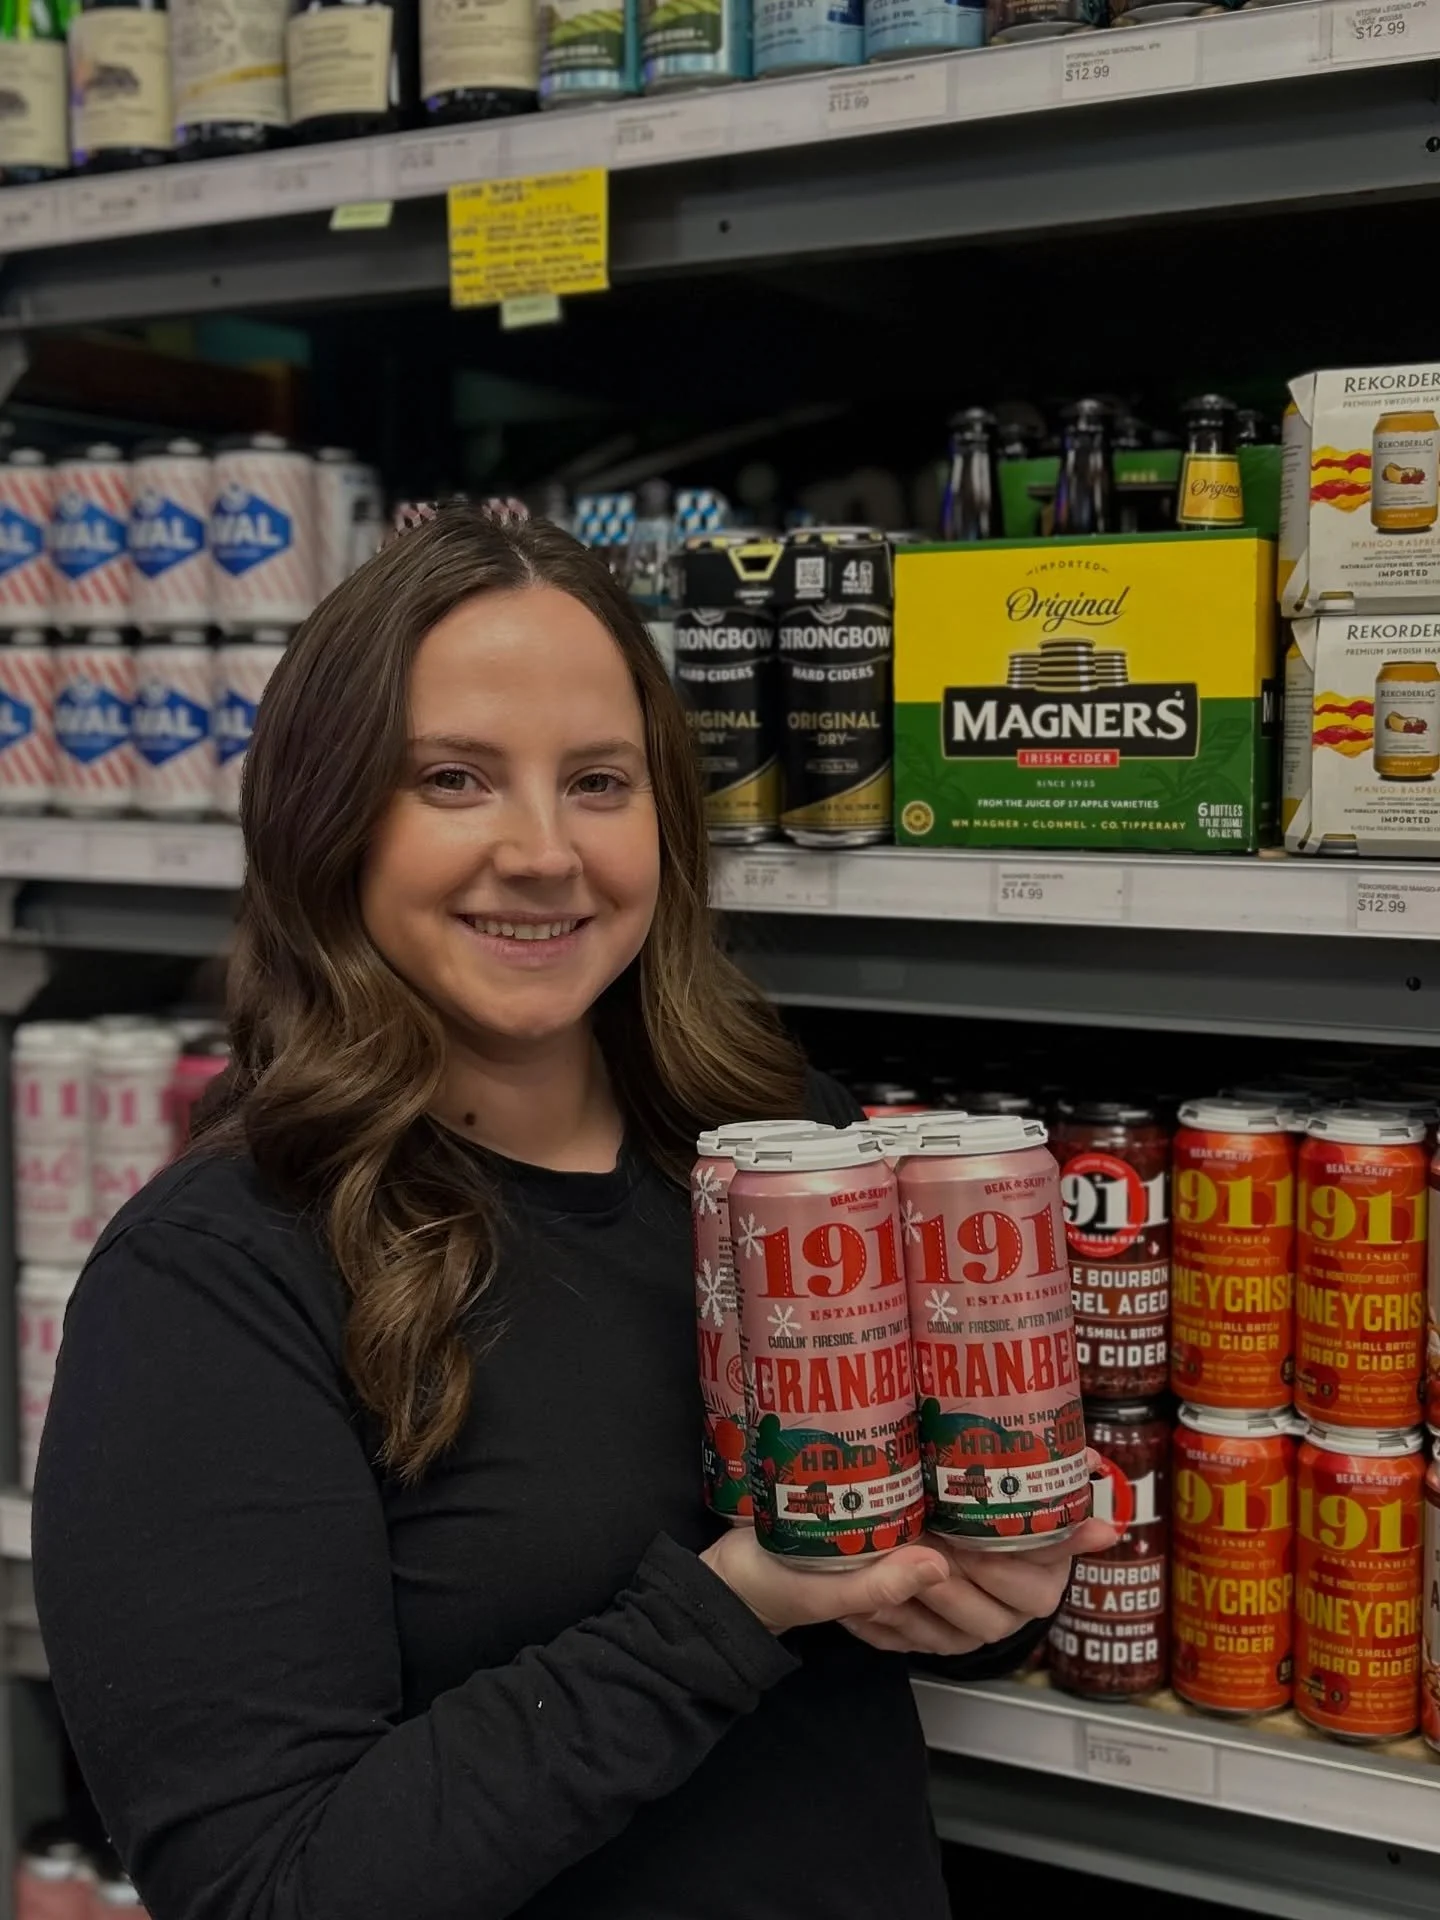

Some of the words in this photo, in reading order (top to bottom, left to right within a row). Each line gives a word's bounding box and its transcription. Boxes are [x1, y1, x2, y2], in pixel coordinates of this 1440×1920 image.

[1356, 21, 1405, 40] $12.99
[1065, 65, 1110, 82] $12.99
[1033, 560, 1102, 574] IMPORTED
[1378, 569, 1428, 578] IMPORTED
[1006, 586, 1131, 633] Original
[674, 626, 775, 651] RONGBOW
[779, 626, 892, 650] STRONGBOW
[1347, 624, 1440, 641] REKORDER
[1346, 647, 1383, 655] PREMIUM
[1386, 647, 1422, 655] SWEDISH
[707, 666, 754, 683] CIDERS
[792, 666, 825, 682] HARD
[827, 666, 875, 683] CIDERS
[1380, 689, 1436, 698] REKORDERLIG
[685, 709, 763, 729] RIGINAL
[787, 711, 881, 730] ORIGINAL
[952, 695, 1188, 742] MAGNERS
[817, 732, 848, 746] DRY
[1024, 753, 1063, 765] IRISH
[1067, 753, 1112, 765] CIDER
[1036, 780, 1066, 788] SINCE
[977, 799, 1003, 808] FROM
[1004, 799, 1024, 808] THE
[1025, 799, 1051, 808] JUICE
[1053, 799, 1066, 808] OF
[1067, 799, 1079, 808] 17
[1080, 799, 1109, 809] APPLE
[1111, 799, 1159, 809] VARIETIES
[1198, 802, 1208, 817] 6
[1210, 804, 1243, 817] BOTTLES
[951, 819, 969, 828] WM
[973, 819, 1020, 829] MAGNER
[1032, 820, 1087, 830] CLONMEL
[1381, 816, 1431, 825] IMPORTED
[1001, 888, 1043, 900] $14.99
[1357, 898, 1406, 913] $12.99
[1326, 1164, 1350, 1175] BEAK
[1363, 1166, 1394, 1178] SKIFF
[985, 1181, 1013, 1195] BEAK
[1014, 1179, 1022, 1188] &
[1023, 1178, 1046, 1190] SKIFF
[830, 1192, 858, 1207] BEAK
[859, 1190, 866, 1199] &
[867, 1188, 889, 1200] SKIFF
[1314, 1246, 1410, 1262] ESTABLISHED
[1087, 1267, 1169, 1288] BOURBON
[1118, 1289, 1169, 1316] AGED
[1018, 1314, 1045, 1329] AFTER
[1047, 1309, 1064, 1325] THAT
[1207, 1318, 1243, 1332] SMALL
[1246, 1320, 1279, 1333] BATCH
[860, 1326, 887, 1343] AFTER
[1087, 1326, 1128, 1340] SMALL
[1131, 1325, 1165, 1340] BATCH
[1219, 1333, 1280, 1352] CIDER
[1345, 1341, 1383, 1352] SMALL
[1385, 1341, 1417, 1352] BATCH
[1098, 1341, 1167, 1368] CIDER
[1301, 1342, 1349, 1369] HARD
[1356, 1353, 1416, 1372] CIDER
[960, 1430, 1035, 1455] HARD
[801, 1444, 877, 1471] HARD
[1026, 1471, 1042, 1481] MADE
[1045, 1467, 1060, 1477] FROM
[1336, 1473, 1365, 1485] BEAK
[1375, 1475, 1404, 1487] SKIFF
[868, 1486, 884, 1495] MADE
[971, 1485, 995, 1498] YORK
[1028, 1484, 1043, 1494] TREE
[1045, 1480, 1053, 1491] TO
[1054, 1478, 1065, 1488] CAN
[812, 1502, 837, 1515] YORK
[870, 1499, 884, 1509] TREE
[886, 1494, 894, 1505] TO
[895, 1491, 905, 1502] CAN
[1075, 1563, 1161, 1587] BOURBON
[1102, 1587, 1161, 1613] AGED
[1074, 1620, 1114, 1638] SMALL
[1116, 1621, 1155, 1638] BATCH
[1204, 1620, 1238, 1635] SMALL
[1240, 1624, 1276, 1636] BATCH
[1084, 1638, 1159, 1665] CIDER
[1213, 1635, 1275, 1654] CIDER
[1356, 1647, 1393, 1658] SMALL
[1308, 1648, 1361, 1677] HARD
